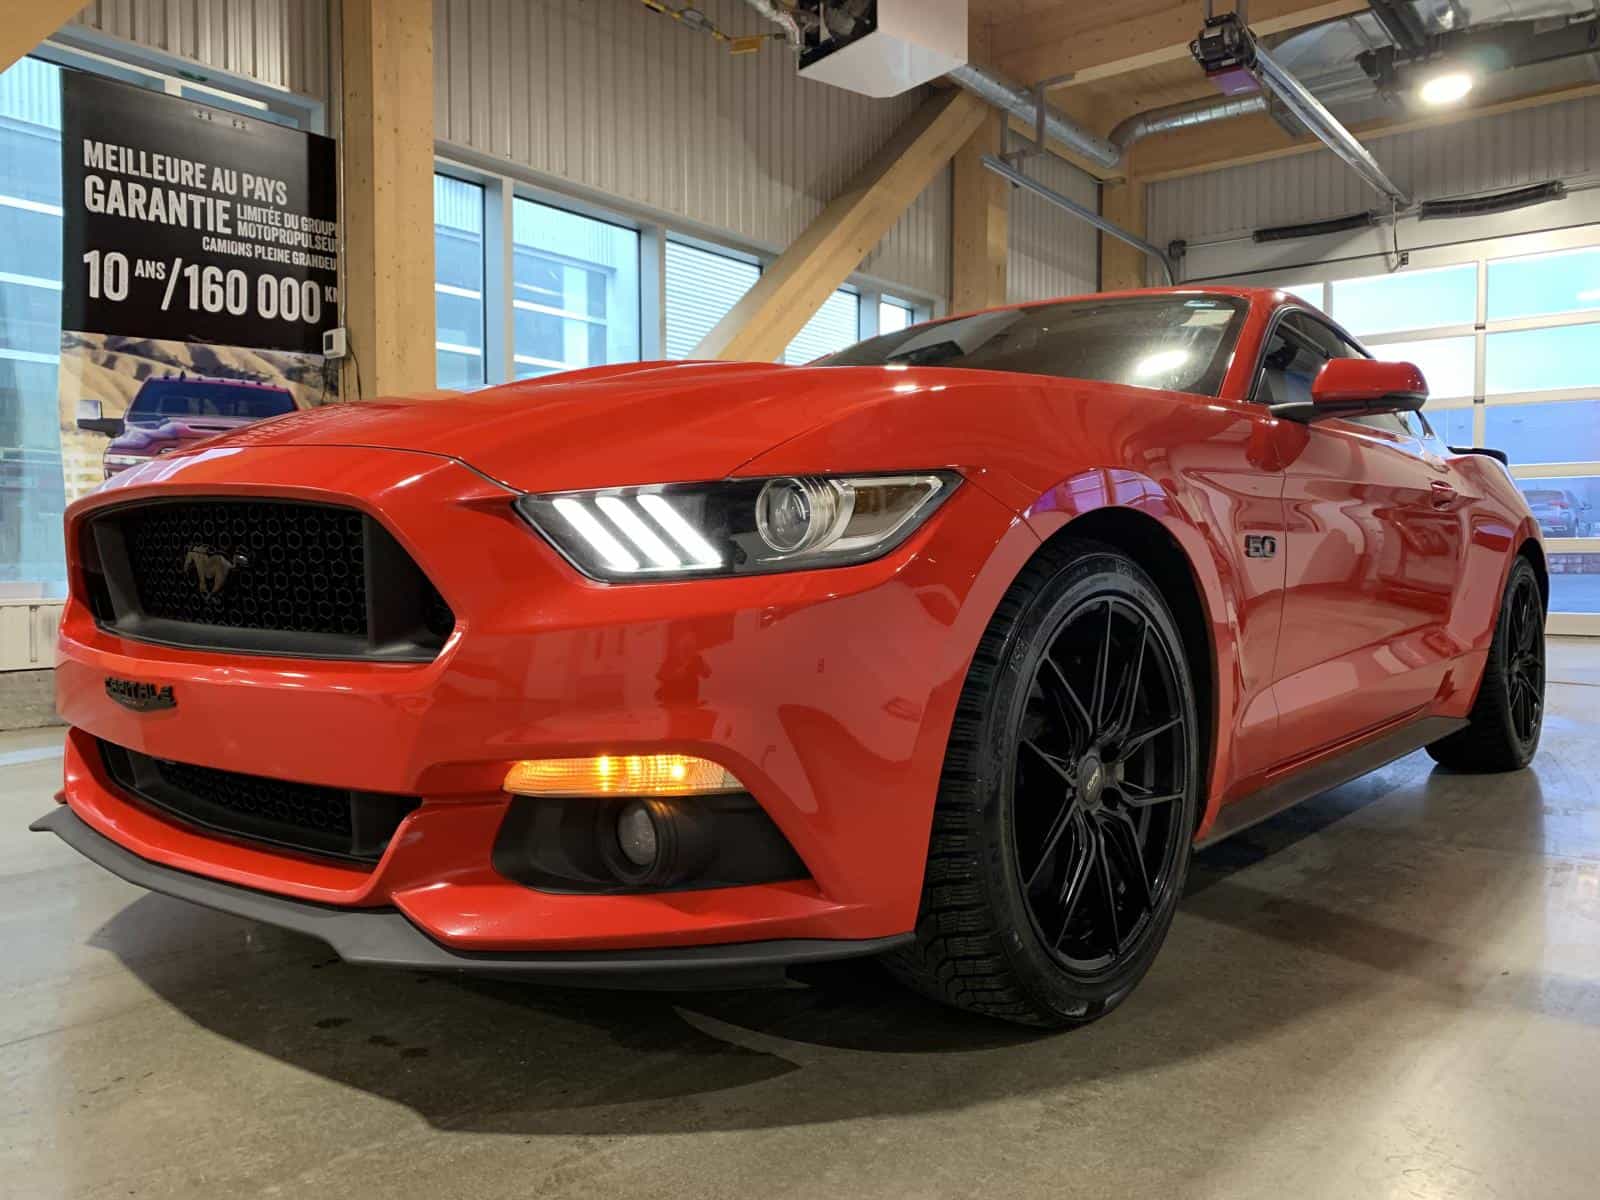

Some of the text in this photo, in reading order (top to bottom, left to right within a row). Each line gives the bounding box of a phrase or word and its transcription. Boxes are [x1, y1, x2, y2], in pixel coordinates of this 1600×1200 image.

[83, 139, 287, 205] MEILLEURE AU PAYS
[84, 175, 232, 234] GARANTIE
[237, 203, 281, 227] LIMITÉE
[284, 213, 299, 229] DU
[202, 236, 336, 271] CAMIONS PLEINE GRANDEU
[237, 220, 337, 252] MOTOPROPULSEU
[83, 250, 129, 301] 10
[257, 274, 321, 324] 000
